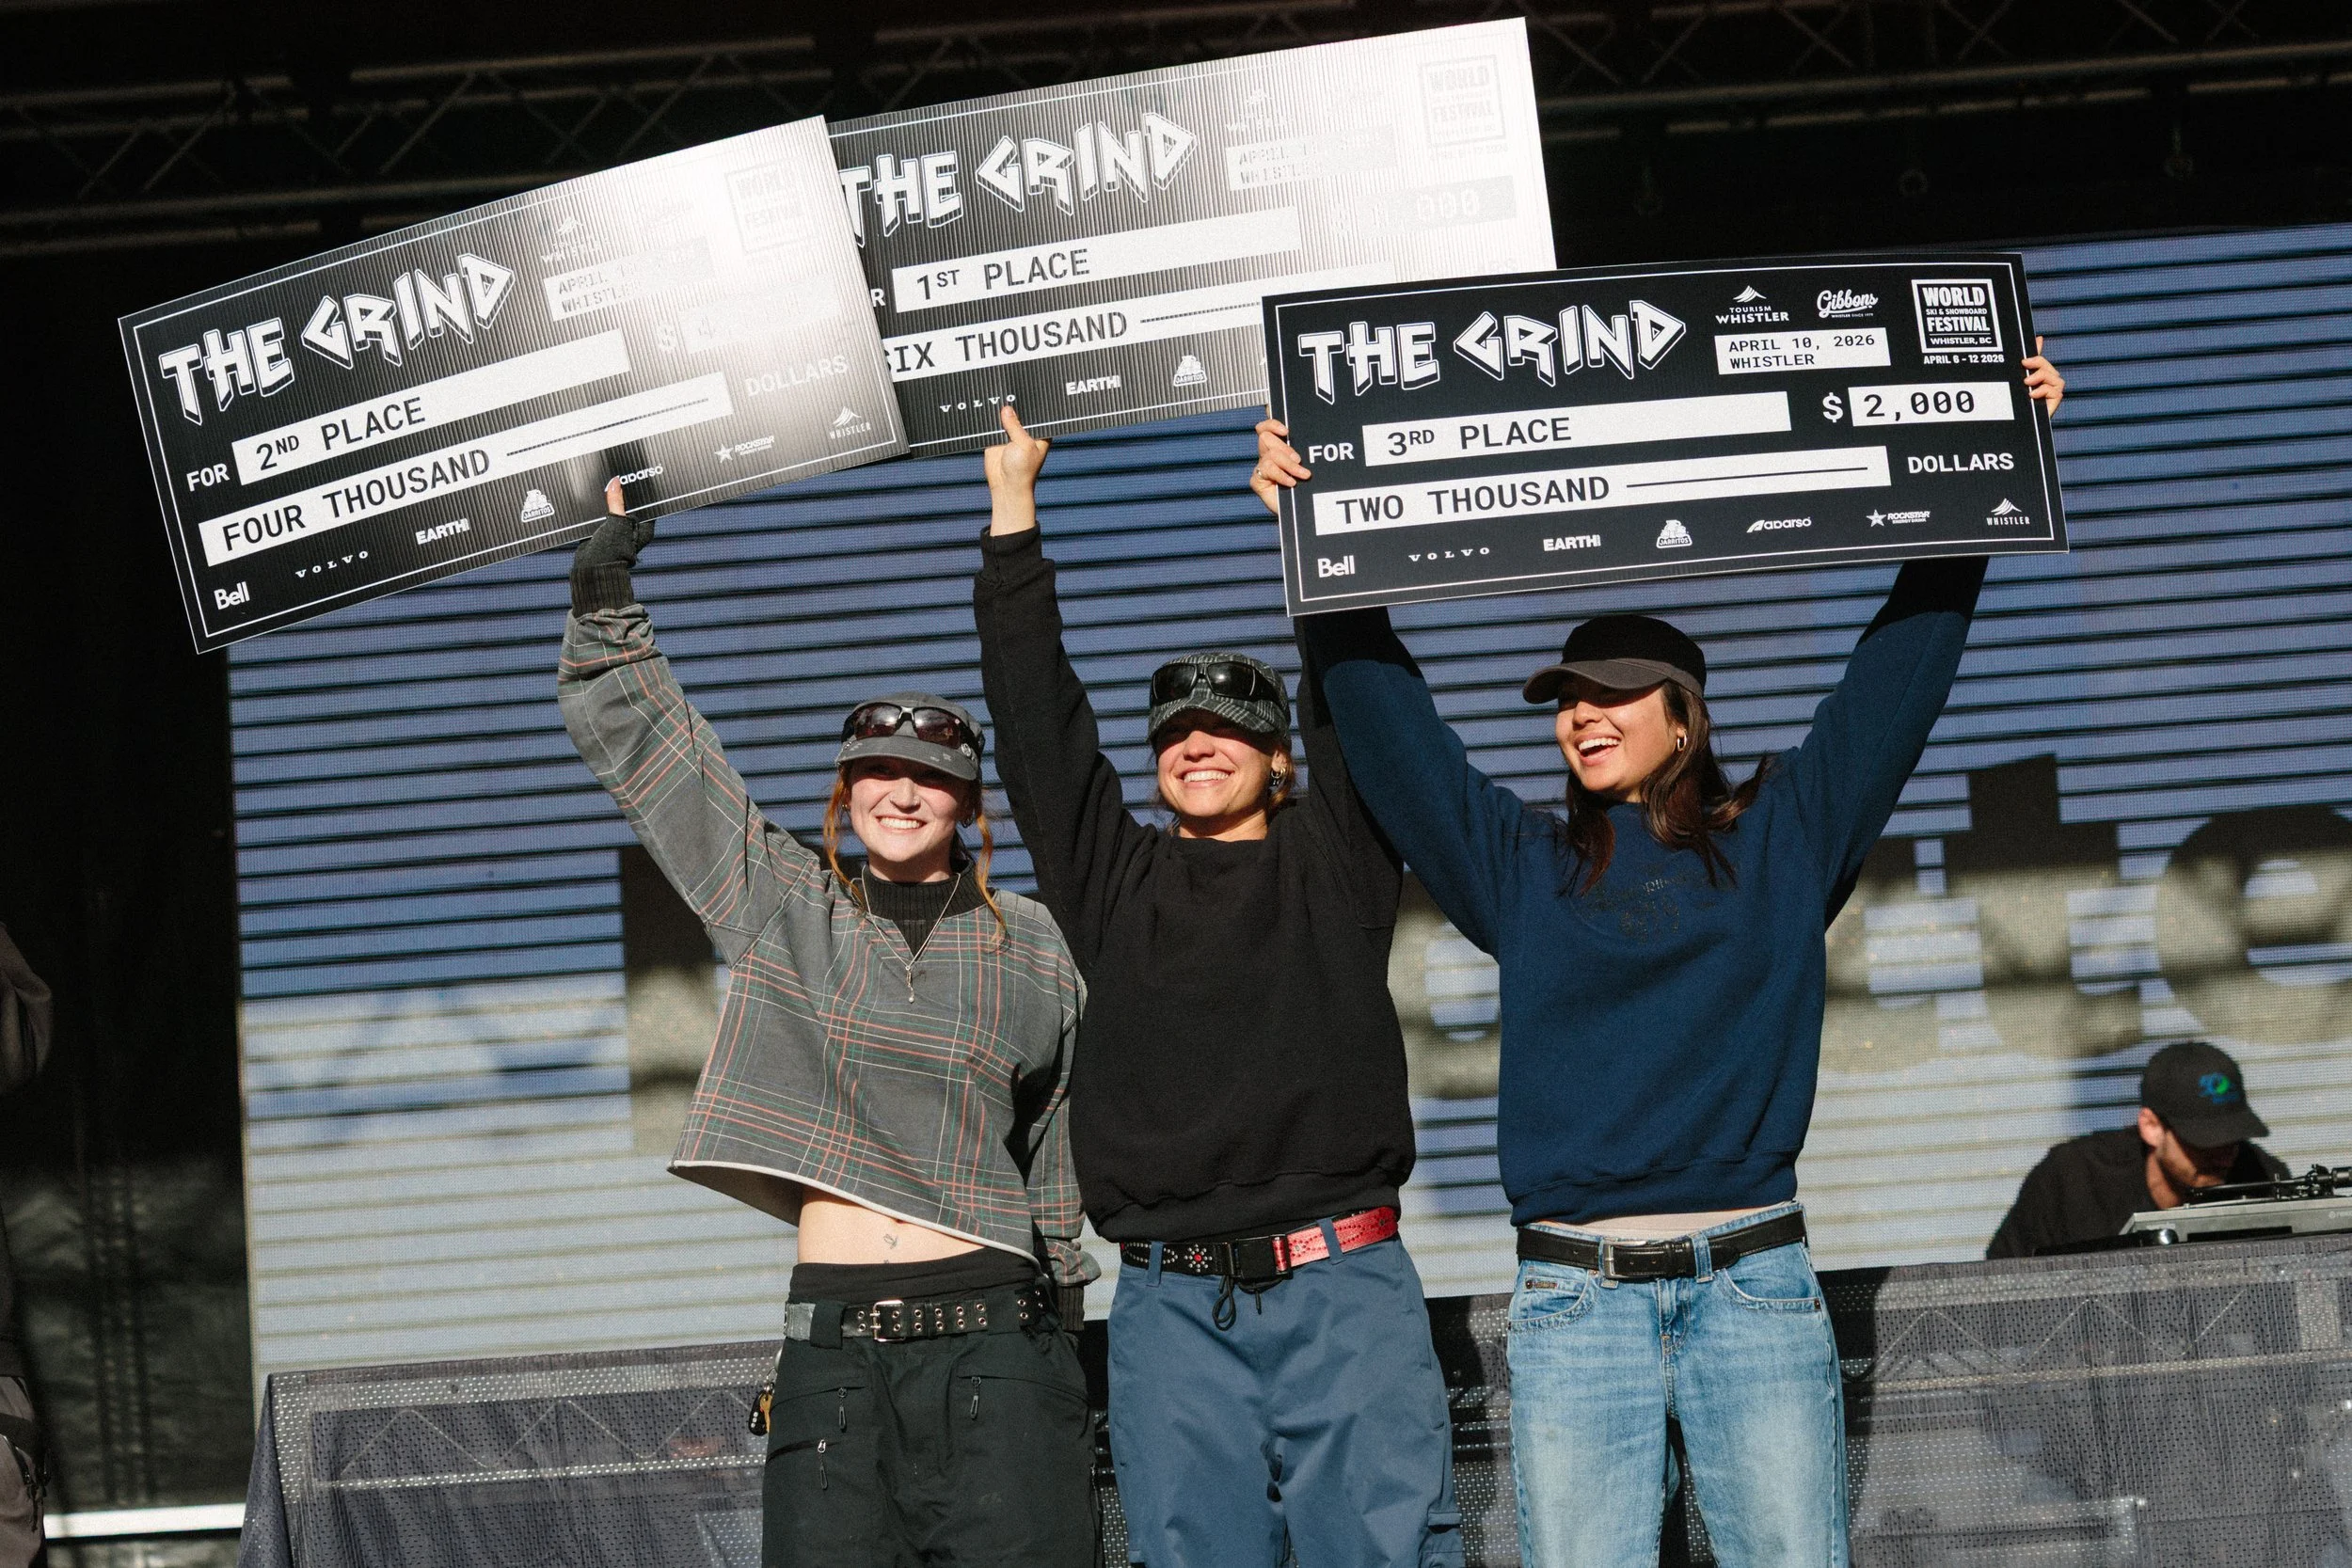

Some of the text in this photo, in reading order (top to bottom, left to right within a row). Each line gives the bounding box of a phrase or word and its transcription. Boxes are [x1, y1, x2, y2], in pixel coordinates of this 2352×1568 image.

[838, 112, 1198, 247] THE GRIND
[916, 269, 961, 301] 1ST
[984, 248, 1091, 290] PLACE
[1817, 289, 1879, 318] Gibbons
[1922, 286, 1986, 307] WORLD
[1715, 311, 1789, 325] WHISTLER
[1729, 306, 1772, 314] TOURISM
[1926, 316, 1991, 332] FESTIVAL
[158, 253, 516, 426] THE GRIND
[955, 311, 1129, 362] THOUSAND
[1728, 334, 1875, 354] APRIL 10, 2026
[1931, 337, 1978, 345] WHISTLER,
[1298, 300, 1686, 405] THE GRIND
[1730, 354, 1816, 370] WHISTLER
[1924, 355, 1951, 365] APRIL
[1968, 354, 1979, 363] 12
[744, 355, 848, 397] DOLLARS
[940, 393, 1017, 413] VOLVO
[1822, 390, 1976, 422] $ 2,000
[829, 422, 872, 440] WHISTLER
[1309, 417, 1572, 464] FOR 3RD PLACE
[186, 397, 426, 492] FOR 2ND PLACE
[1907, 452, 2014, 474] DOLLARS
[221, 448, 491, 552] FOUR THOUSAND
[1336, 475, 1610, 525] TWO THOUSAND
[1887, 511, 1931, 520] ROCKSTAR
[1986, 516, 2030, 526] WHISTLER
[294, 550, 370, 579] VOLVO
[1408, 546, 1490, 562] VOLVO
[1317, 555, 1356, 578] Bell
[214, 581, 250, 610] Bell
